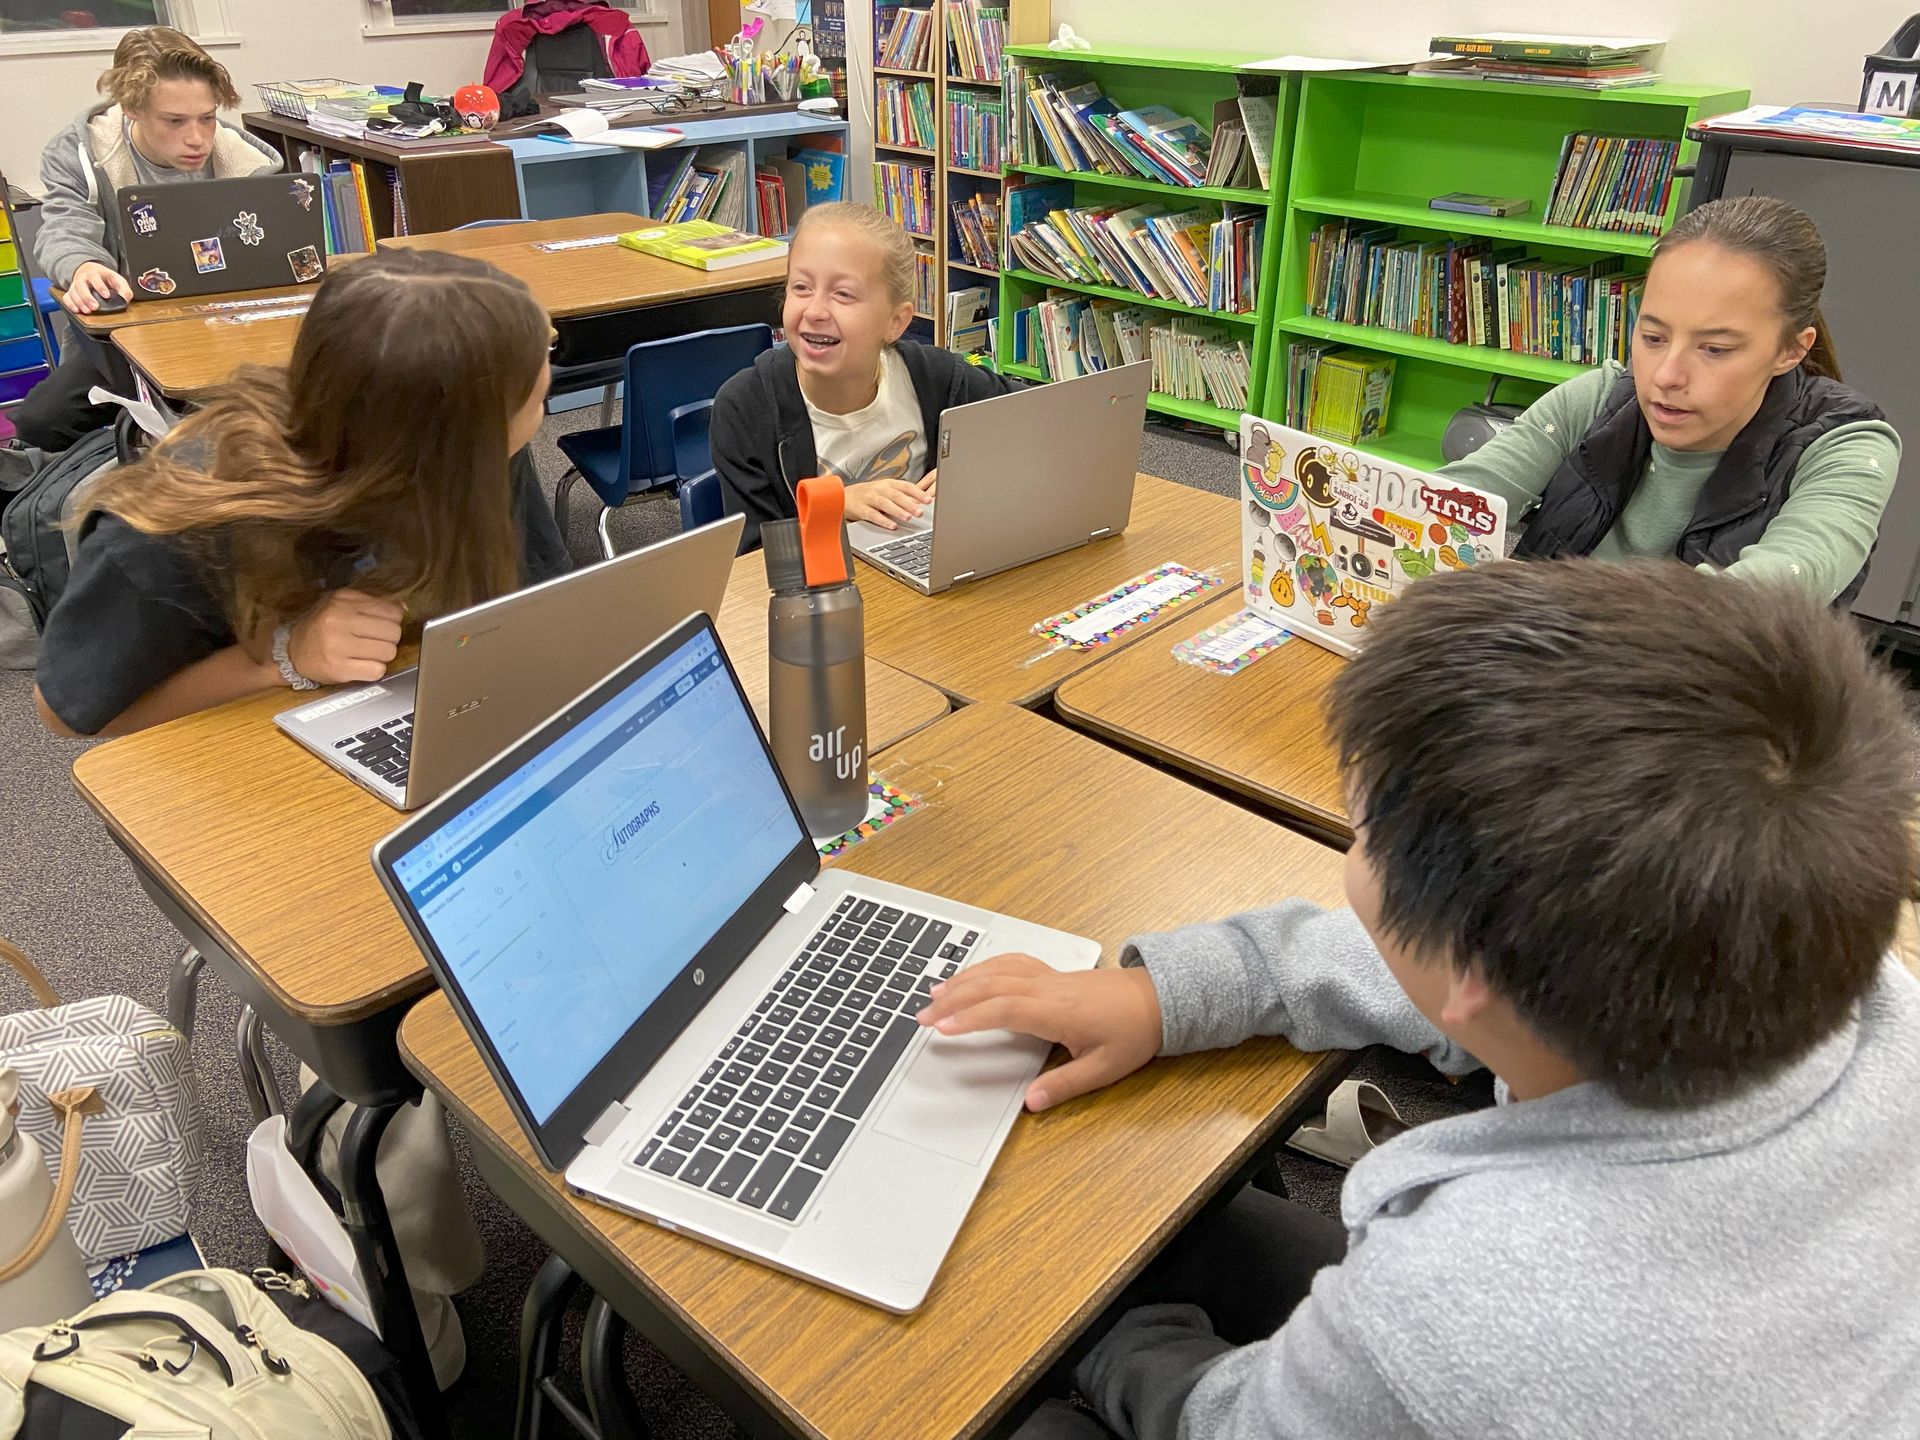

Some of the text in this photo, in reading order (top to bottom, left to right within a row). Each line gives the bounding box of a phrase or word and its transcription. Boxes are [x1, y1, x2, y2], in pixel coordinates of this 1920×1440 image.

[1876, 80, 1907, 112] M
[139, 224, 157, 233] JUST
[1252, 481, 1288, 504] LUCKY
[1423, 490, 1494, 533] STJL
[808, 725, 846, 762] air
[836, 744, 862, 780] up
[601, 800, 661, 866] AUTOGRAPHS
